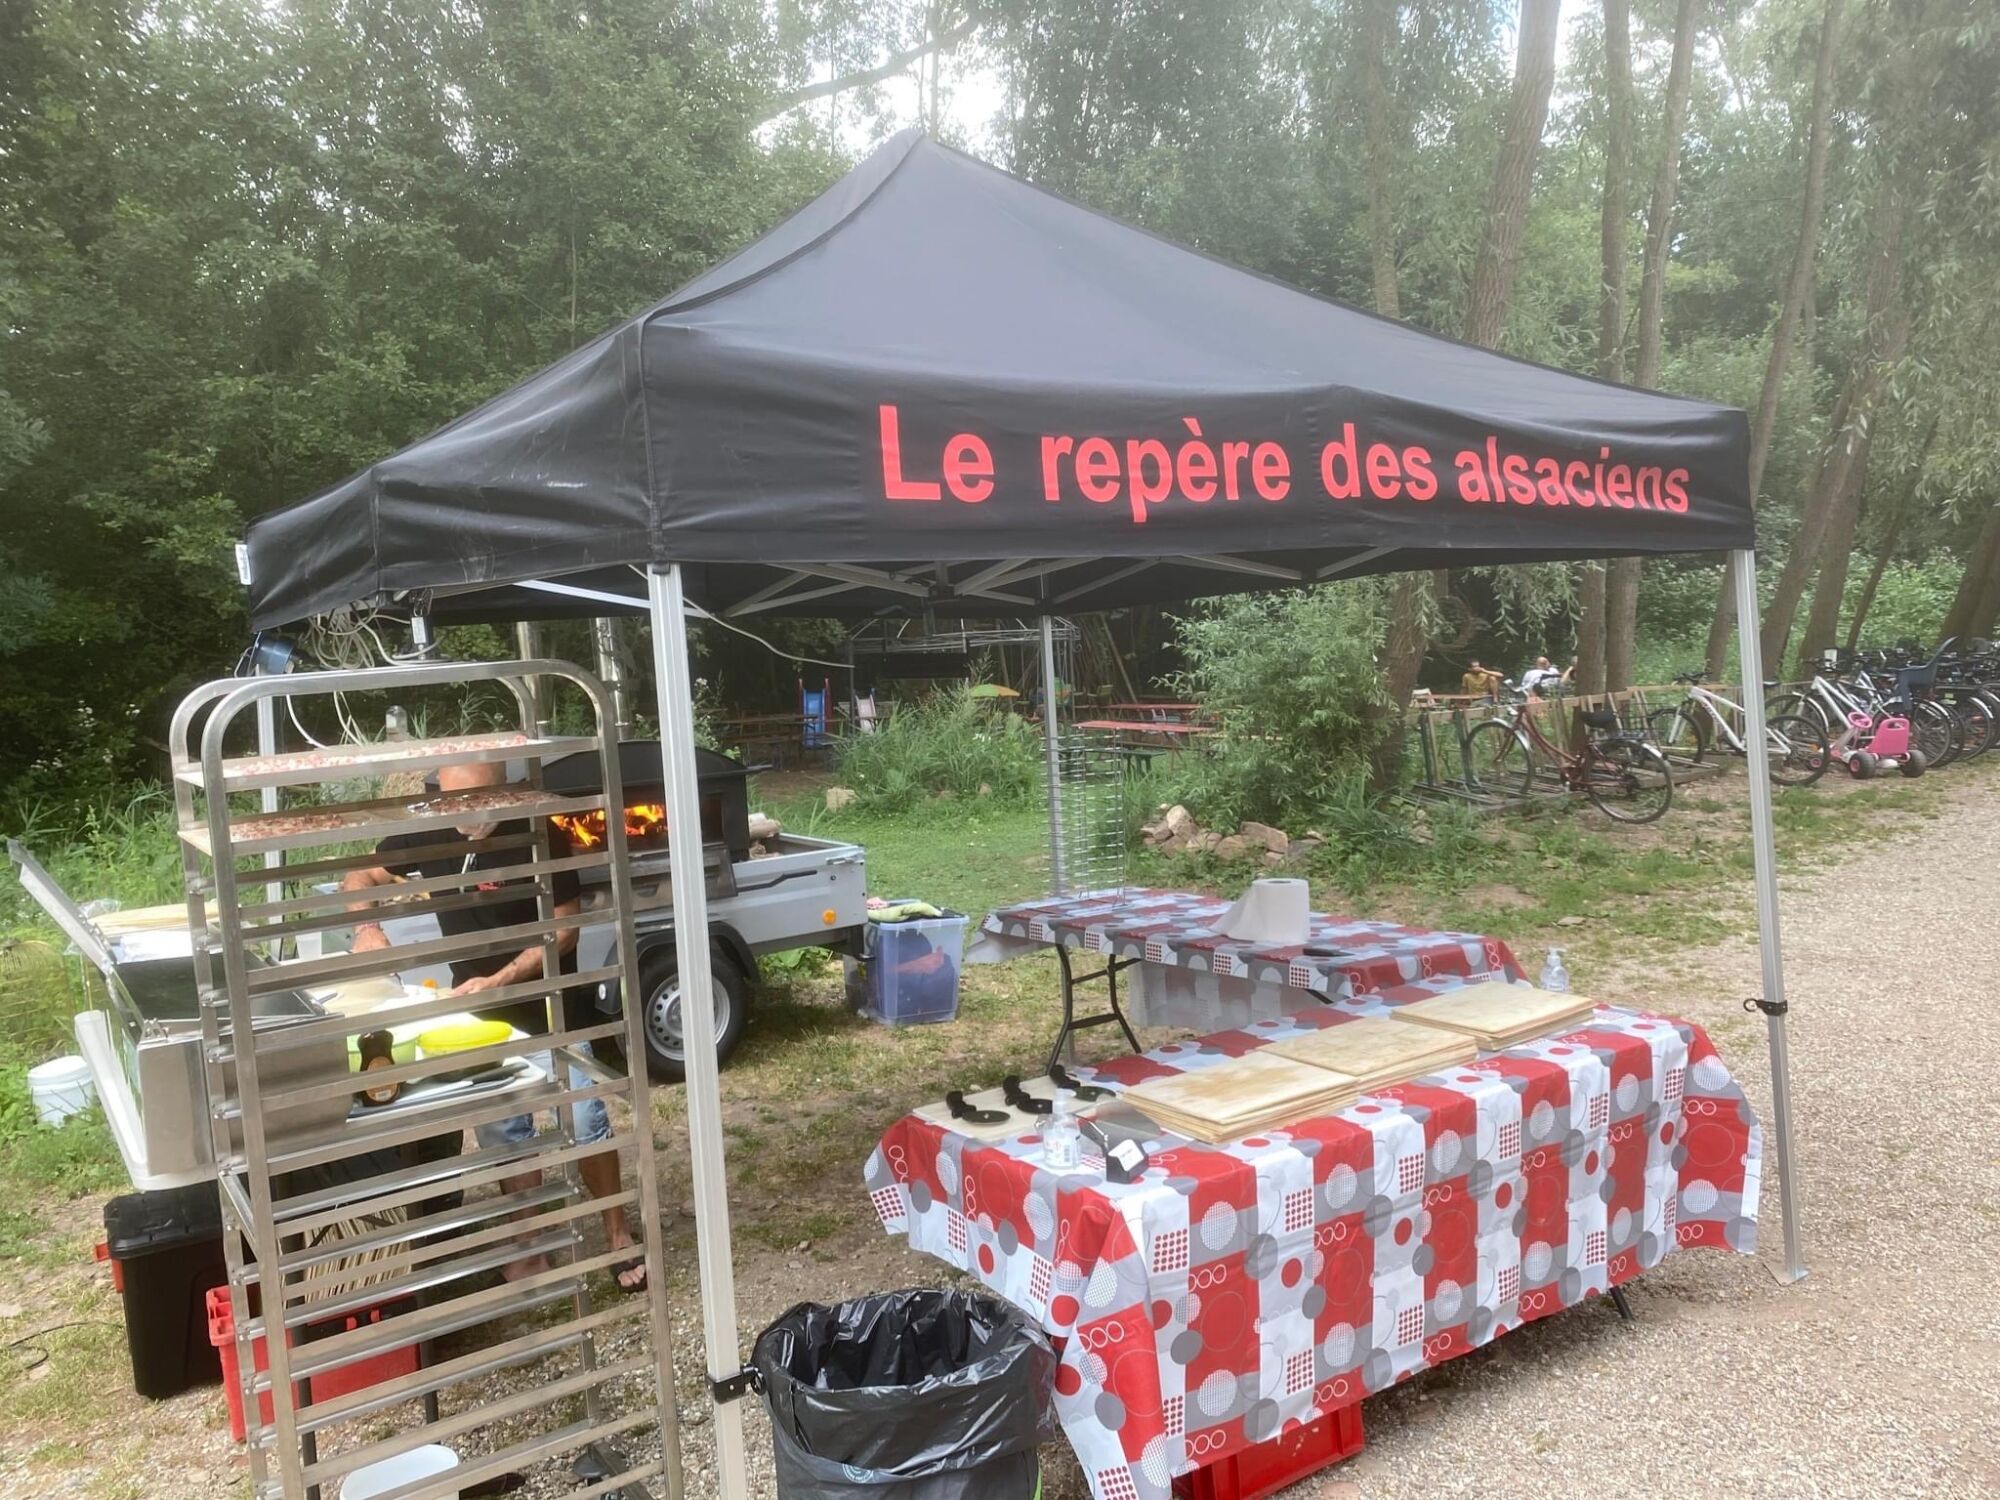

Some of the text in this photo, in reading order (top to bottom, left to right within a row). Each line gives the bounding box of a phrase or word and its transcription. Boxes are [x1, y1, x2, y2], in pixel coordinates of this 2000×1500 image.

[879, 404, 1690, 524] Le repère des alsaciens
